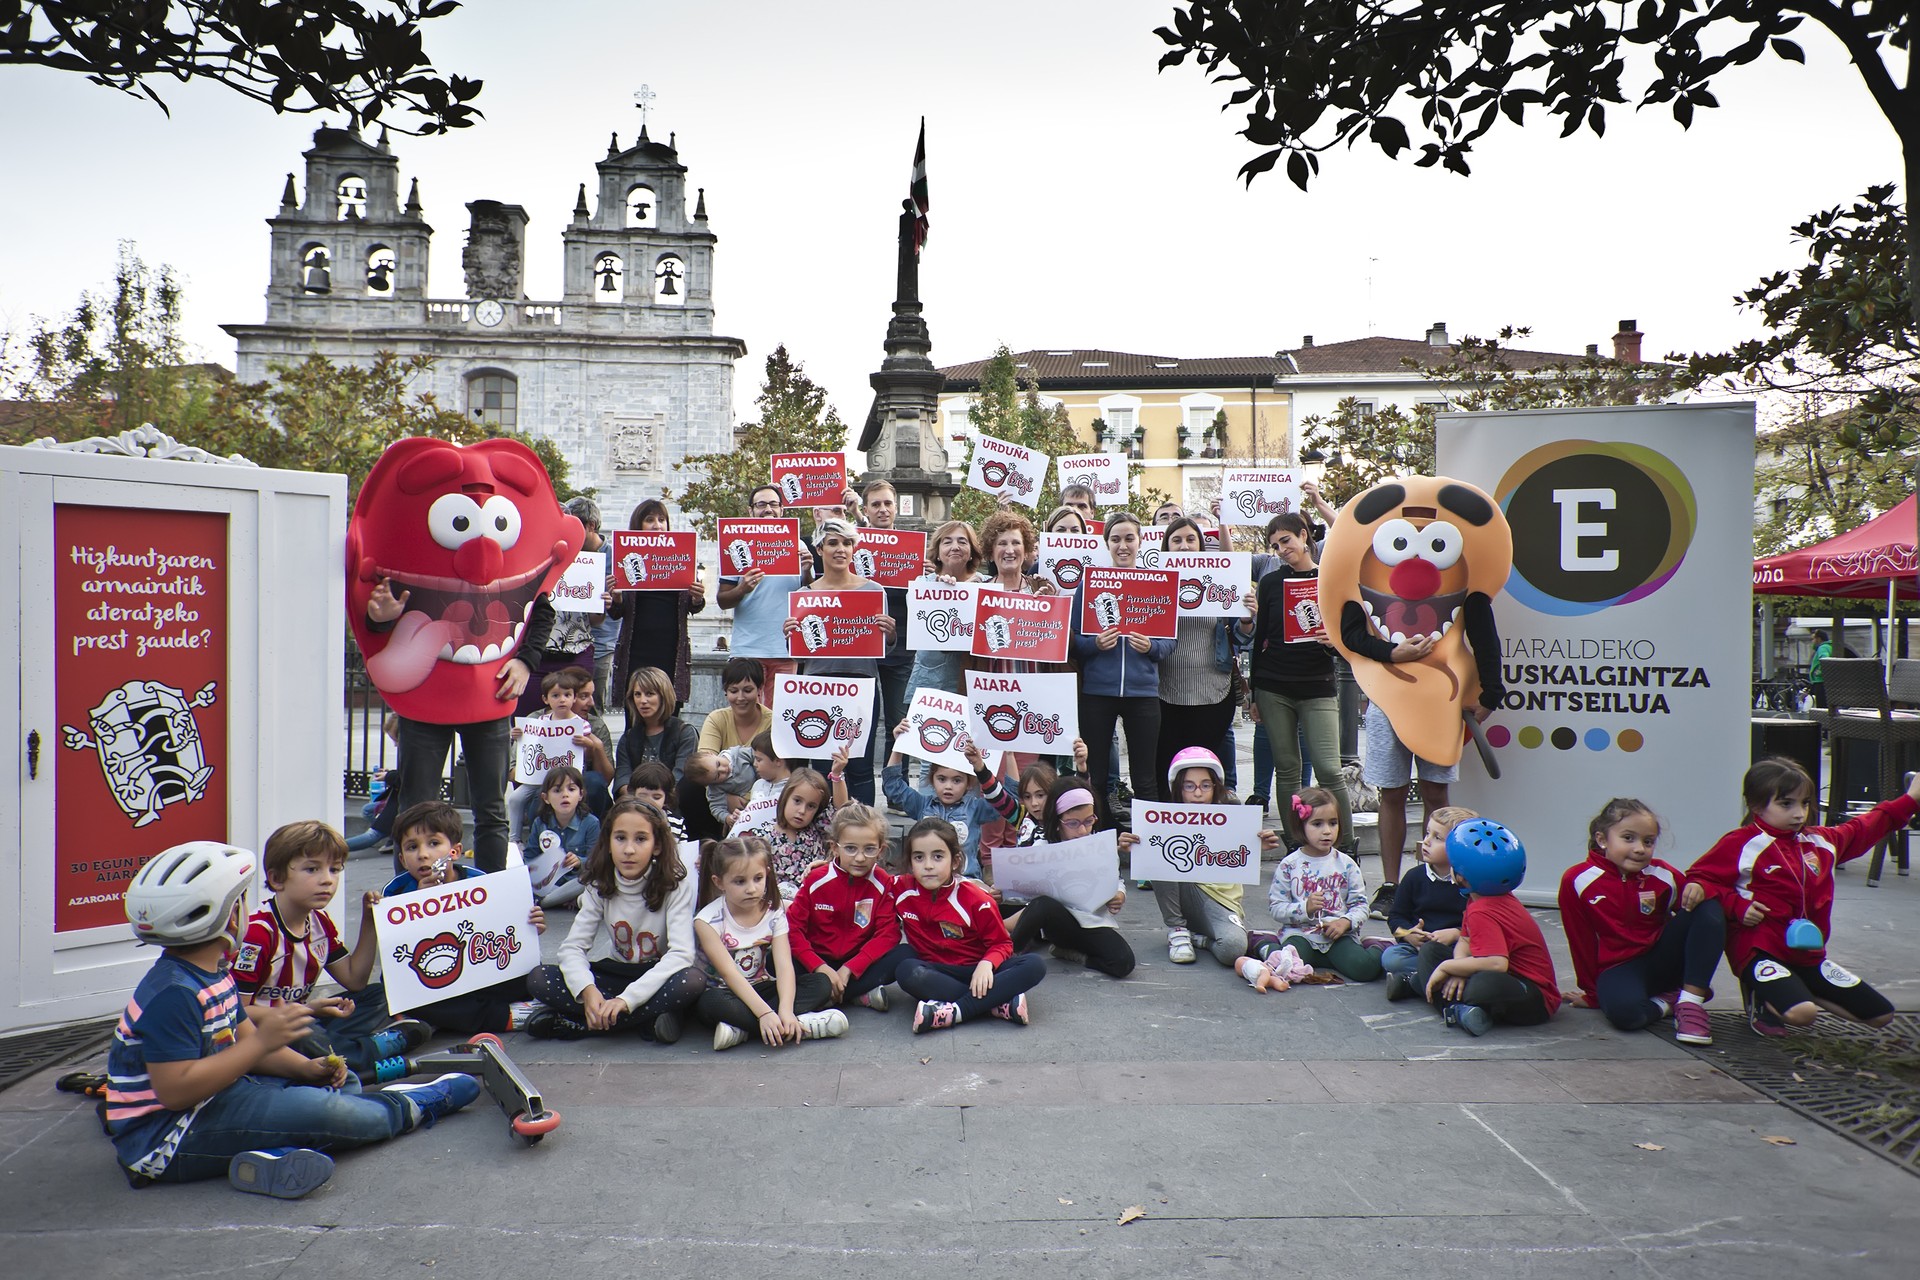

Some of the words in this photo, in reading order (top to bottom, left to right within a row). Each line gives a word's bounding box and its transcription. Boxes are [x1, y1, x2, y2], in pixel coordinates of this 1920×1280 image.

[982, 438, 1029, 462] URDUÑA
[775, 457, 837, 468] ARAKALDO
[1063, 458, 1110, 470] OKONDO
[1229, 473, 1292, 483] ARTZINIEGA
[723, 524, 790, 535] ARTZINIEGA
[1553, 488, 1619, 571] E
[620, 534, 676, 547] URDUÑA
[859, 532, 899, 545] AUDIO
[1047, 537, 1098, 549] LAUDIO
[70, 545, 216, 576] Hizkuntzaren
[1165, 557, 1231, 569] AMURRIO
[1090, 570, 1168, 582] ARRANKUDIAGA
[81, 575, 206, 596] armairutik
[1089, 580, 1122, 589] ZOLLO
[797, 596, 842, 608] AIARA
[915, 588, 969, 601] LAUDIO
[981, 595, 1051, 613] AMURRIO
[86, 600, 199, 630] ateratzeko
[73, 628, 128, 656] prest
[136, 628, 211, 657] zaude?
[1500, 638, 1655, 661] IARALDEKO
[1502, 664, 1711, 688] USKALGINTZA
[784, 680, 859, 697] OKONDO
[973, 677, 1022, 693] AIARA
[917, 695, 963, 716] AIARA
[1499, 690, 1671, 714] ONTSEILUA
[524, 724, 575, 737] ARAKALDO
[1145, 810, 1228, 826] OROZKO
[71, 863, 88, 873] 30
[93, 858, 133, 871] EGUN
[68, 892, 119, 906] AZAROAK
[387, 886, 487, 926] OROZKO
